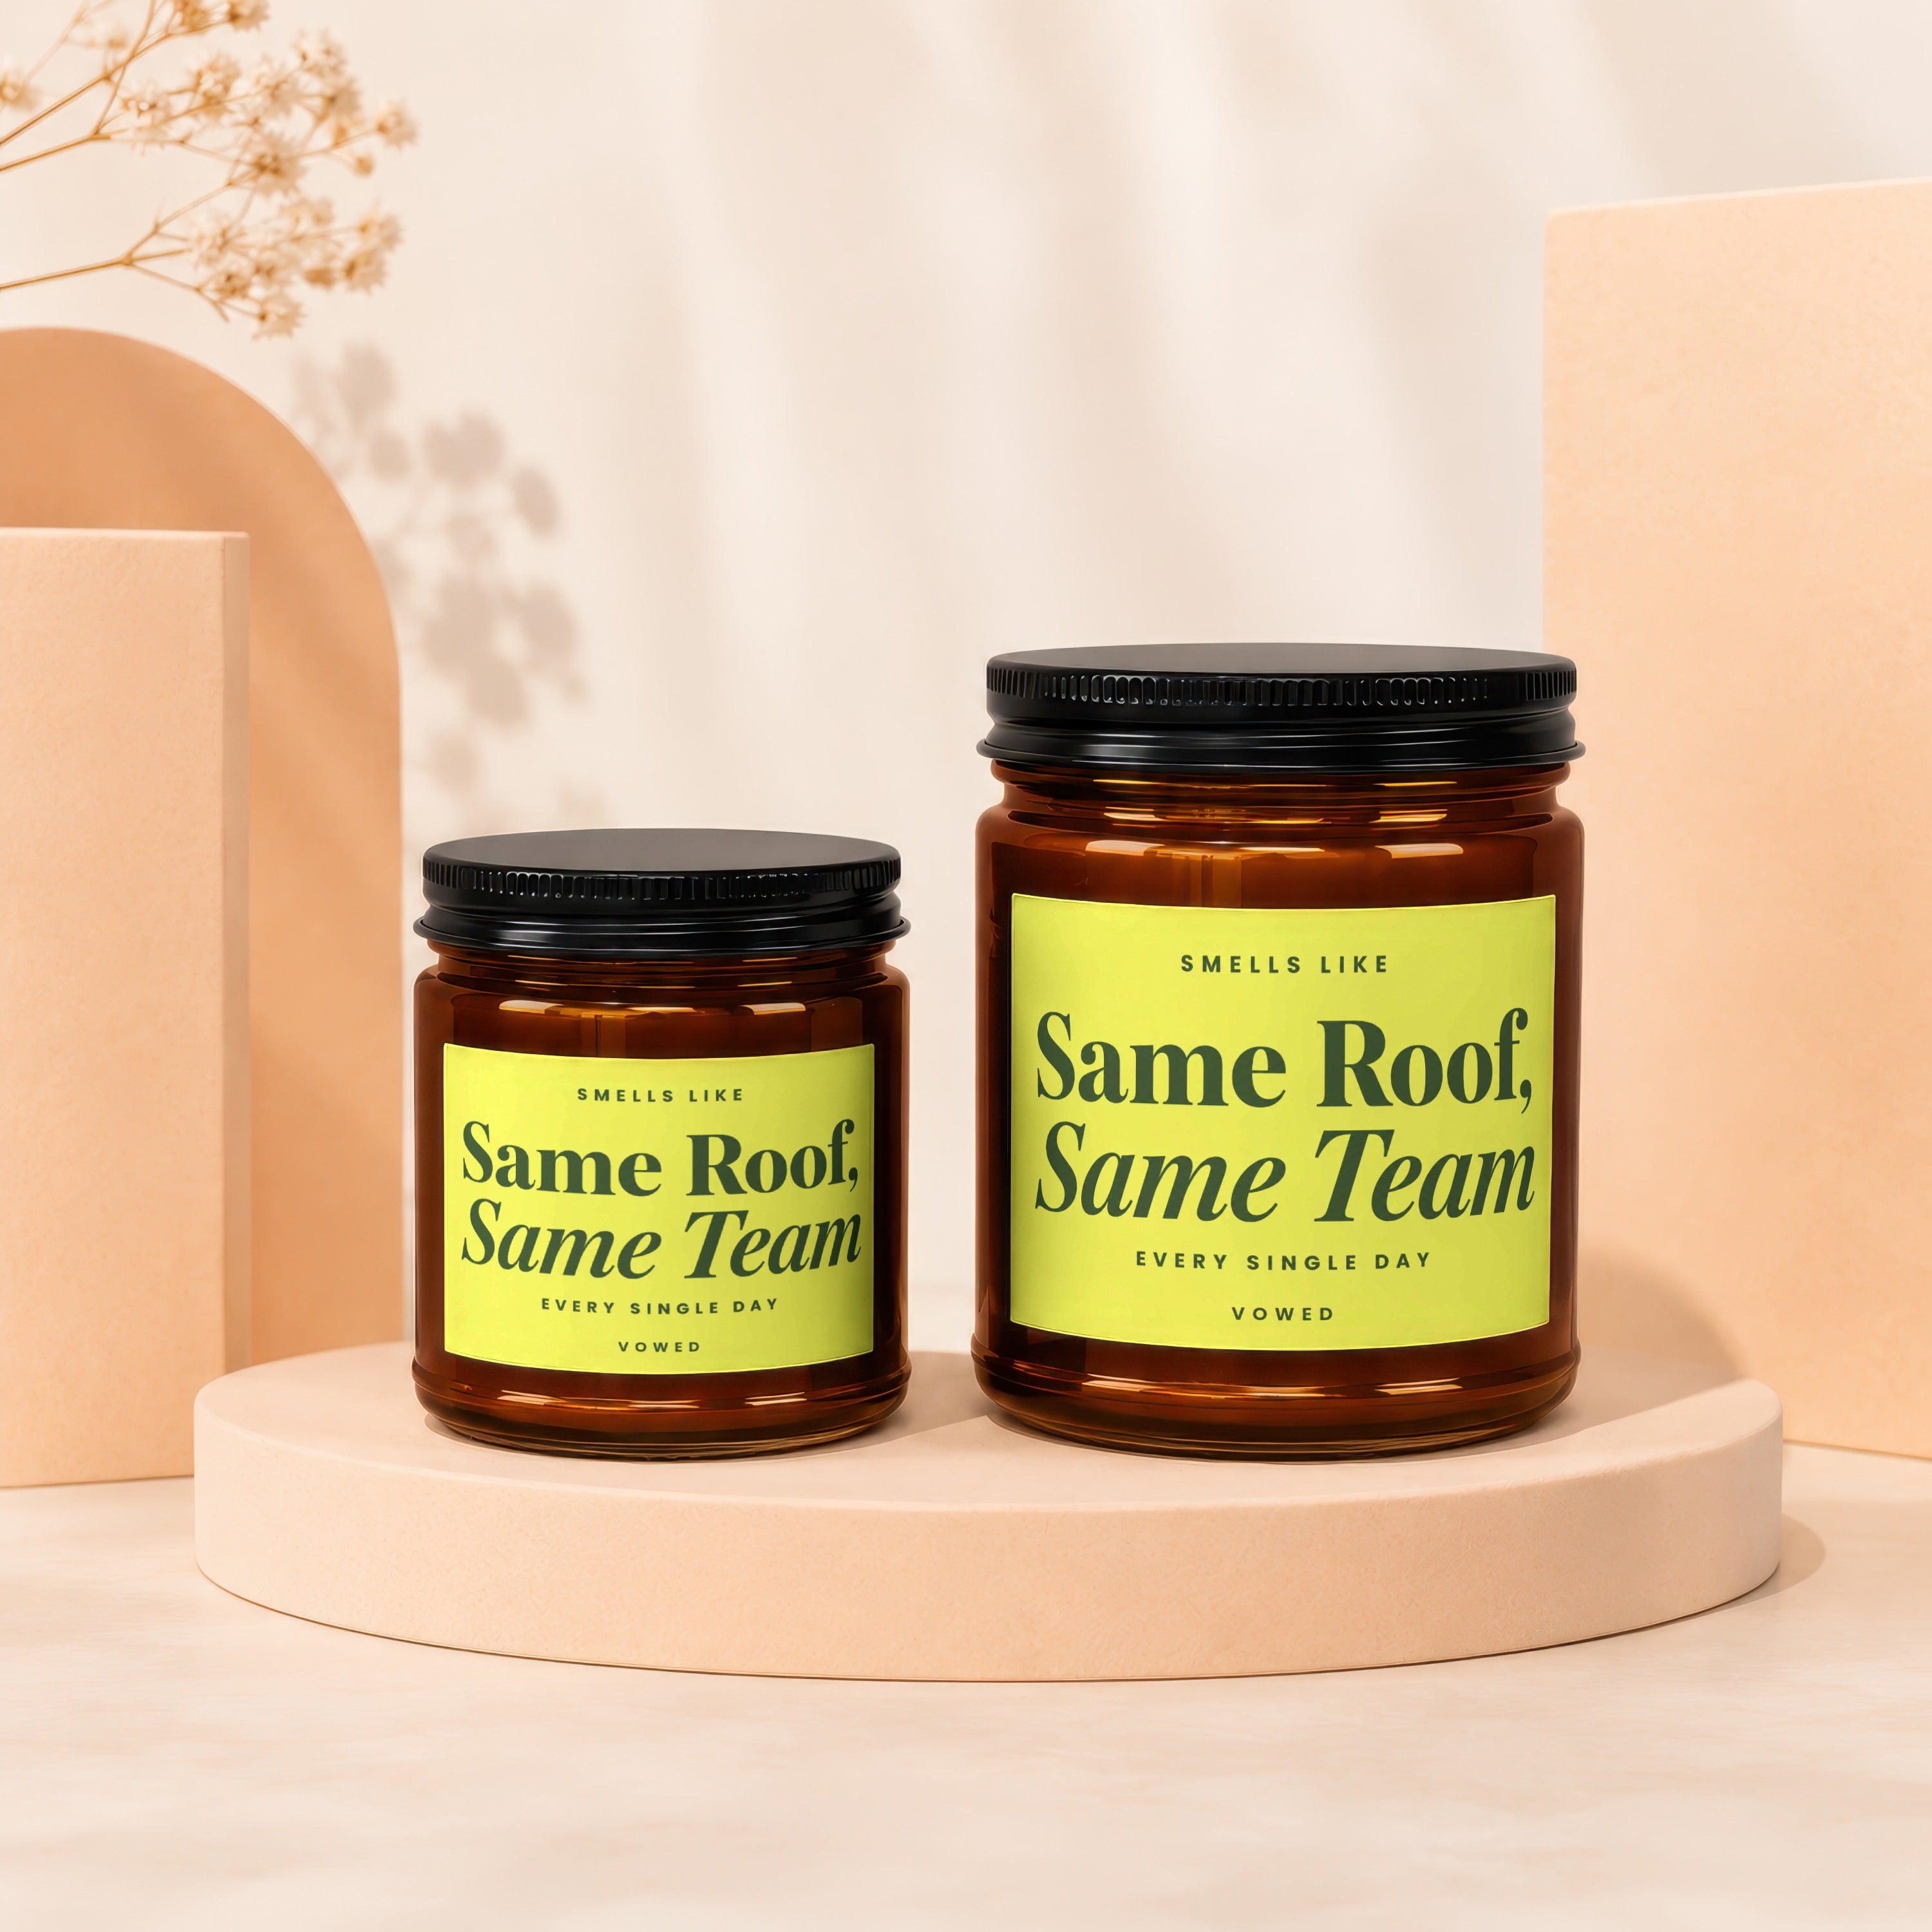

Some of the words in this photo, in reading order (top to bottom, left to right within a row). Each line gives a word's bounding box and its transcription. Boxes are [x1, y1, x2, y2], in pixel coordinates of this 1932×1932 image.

[1181, 954, 1300, 974] SMELLS
[1321, 955, 1387, 974] LIKE
[1036, 1010, 1286, 1108] Same
[1316, 1007, 1533, 1115] Roof,
[577, 1088, 673, 1103] SMELLS
[689, 1088, 743, 1103] LIKE
[462, 1120, 662, 1197] Same
[685, 1118, 858, 1197] Roof,
[1034, 1121, 1286, 1223] Same
[1314, 1129, 1536, 1223] Team
[460, 1197, 662, 1280] Same
[684, 1209, 862, 1280] Team
[1137, 1250, 1227, 1270] EVERY
[1247, 1254, 1356, 1271] SINGLE
[1374, 1251, 1430, 1270] DAY
[541, 1297, 615, 1314] EVERY
[630, 1302, 719, 1315] SINGLE
[732, 1297, 778, 1313] DAY
[1231, 1306, 1334, 1321] VOWED
[618, 1341, 701, 1353] VOWED
